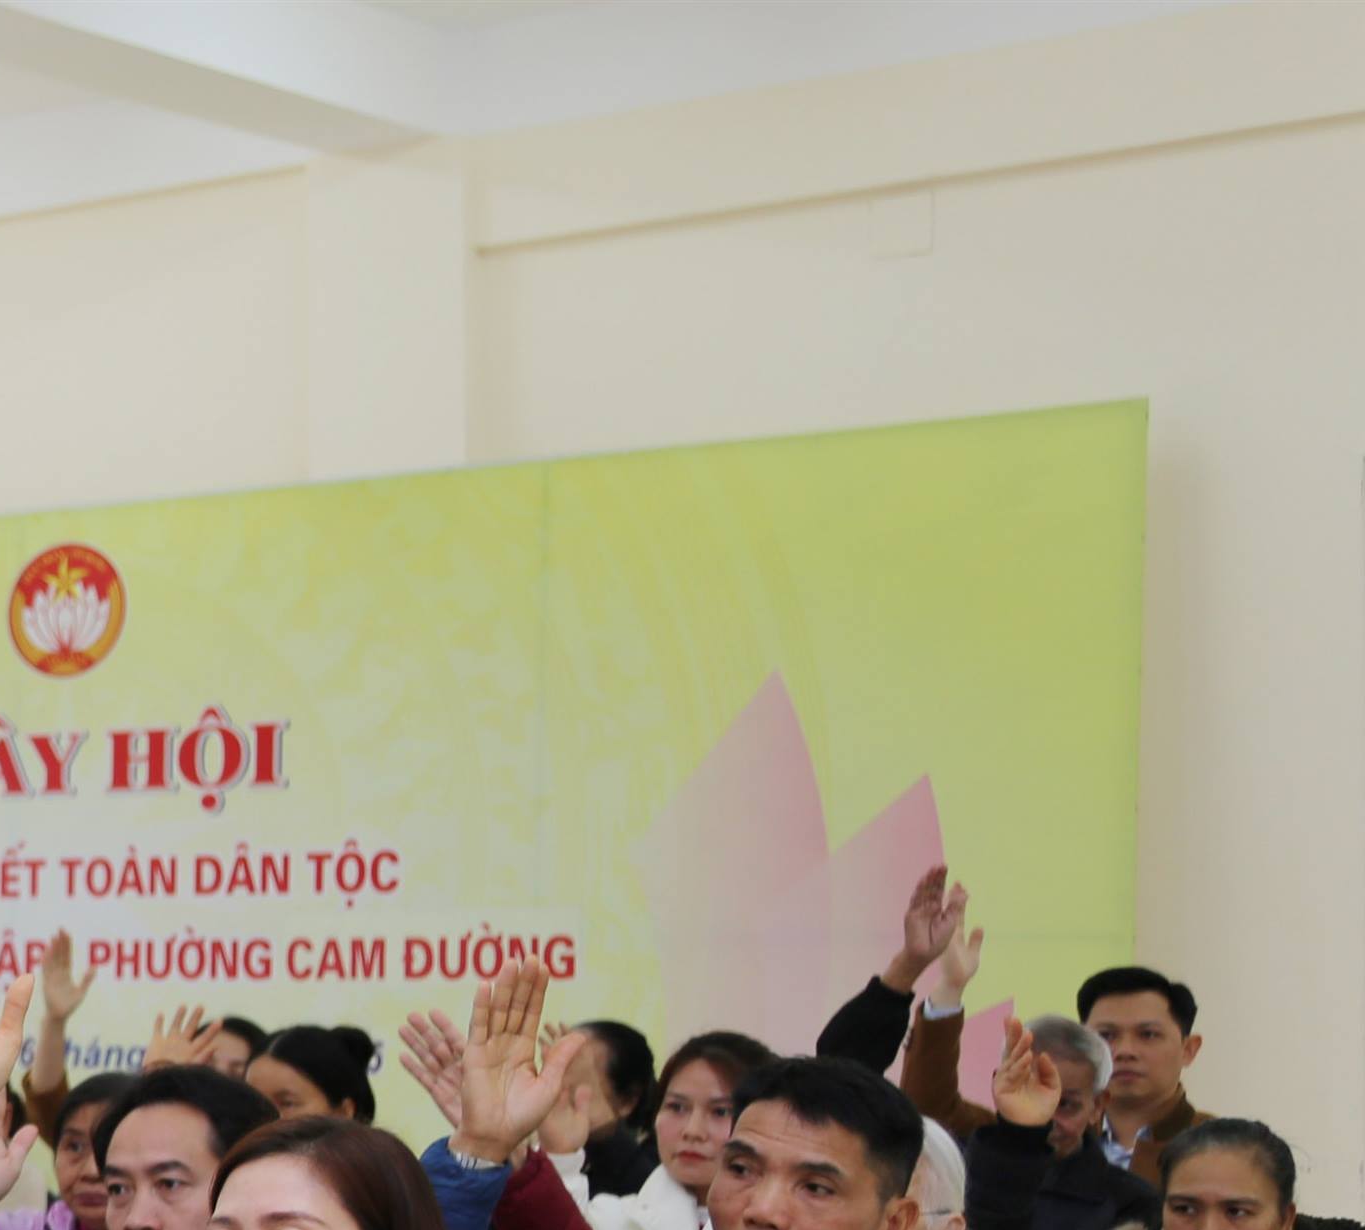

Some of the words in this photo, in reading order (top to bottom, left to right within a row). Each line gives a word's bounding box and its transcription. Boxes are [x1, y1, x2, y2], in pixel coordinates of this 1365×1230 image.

[109, 705, 286, 814] HỘI
[60, 846, 179, 898] TOÀN
[193, 843, 292, 896] DÂN
[306, 839, 400, 908] TỘC
[88, 925, 274, 982] PHƯỜNG
[286, 936, 387, 981] CAM
